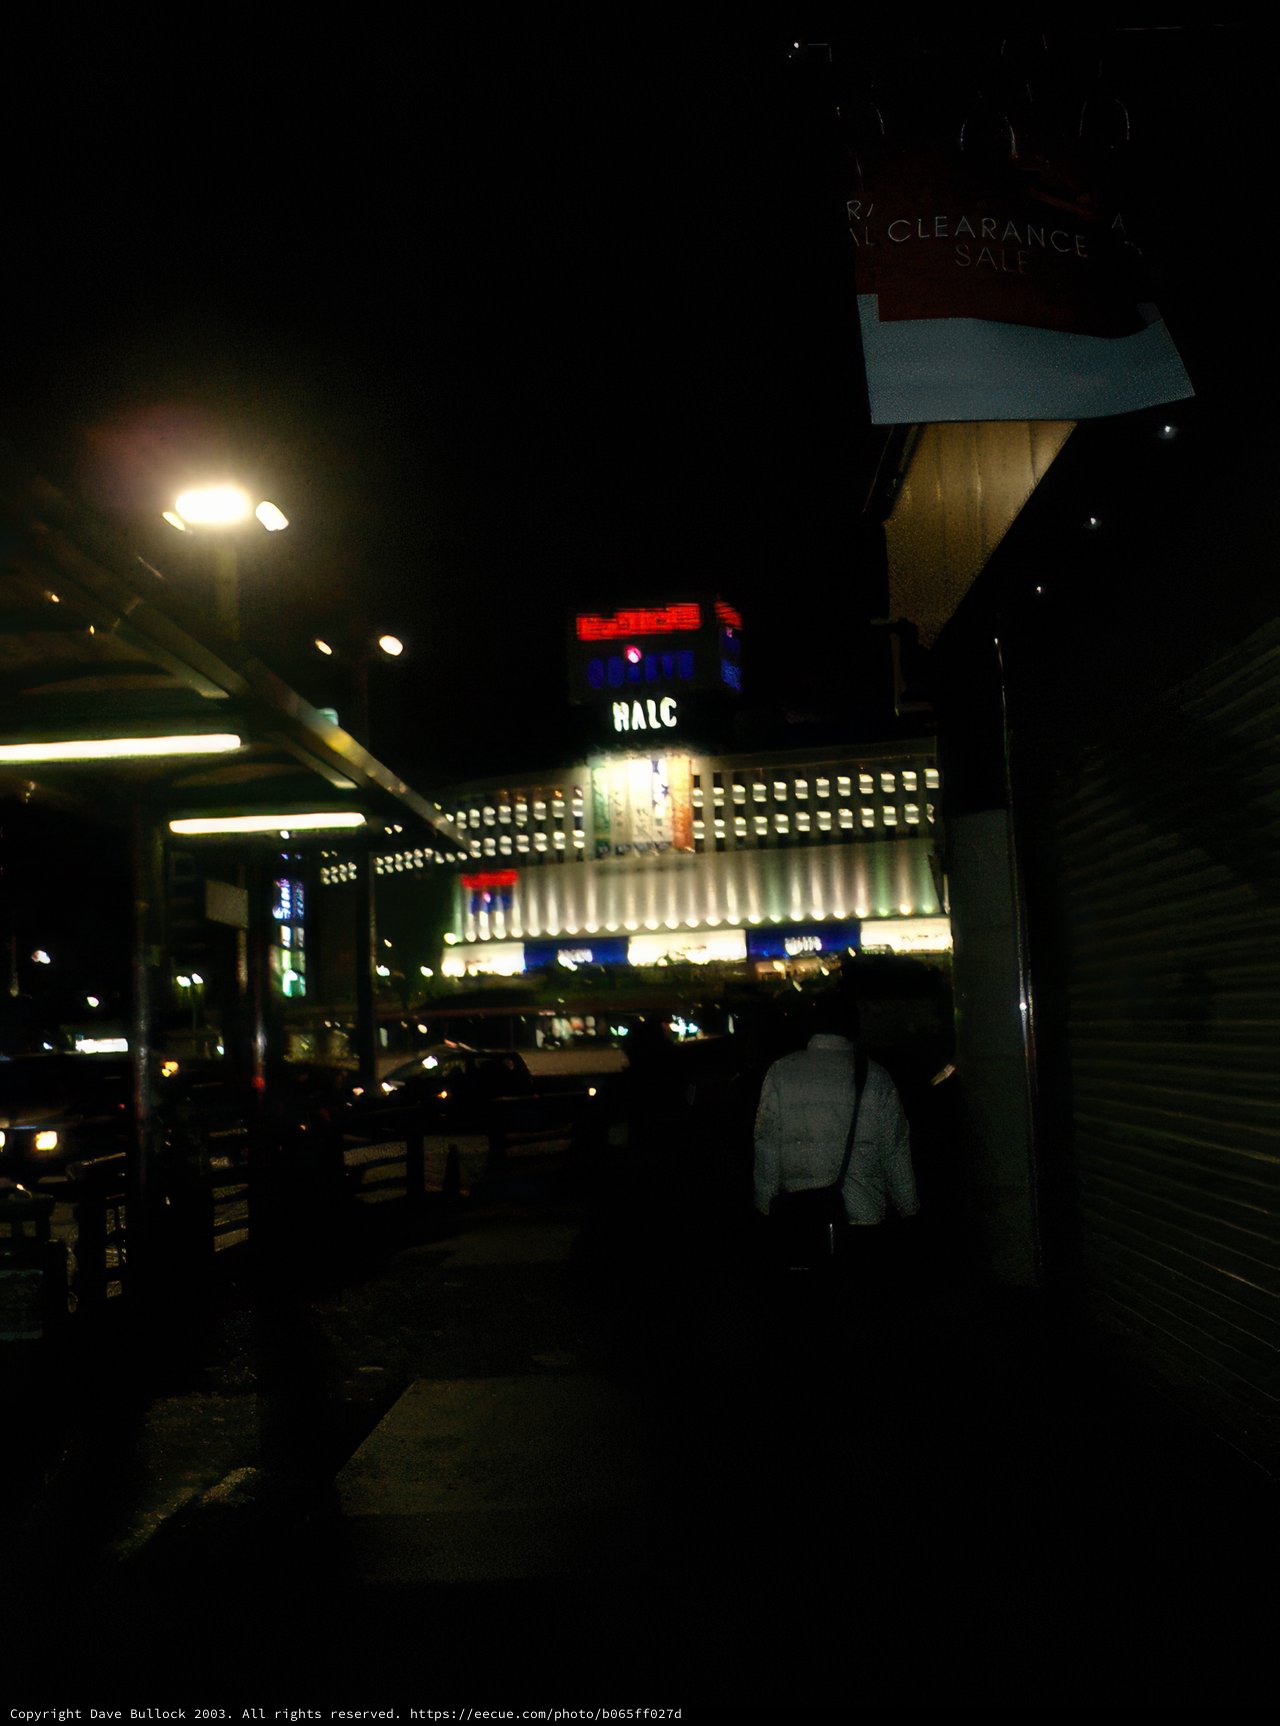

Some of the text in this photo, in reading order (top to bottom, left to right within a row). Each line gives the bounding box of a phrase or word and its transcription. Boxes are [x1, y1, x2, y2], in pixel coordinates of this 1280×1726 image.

[887, 214, 1090, 258] CLEARANCE
[954, 243, 1032, 275] SALE
[611, 696, 678, 733] HALC
